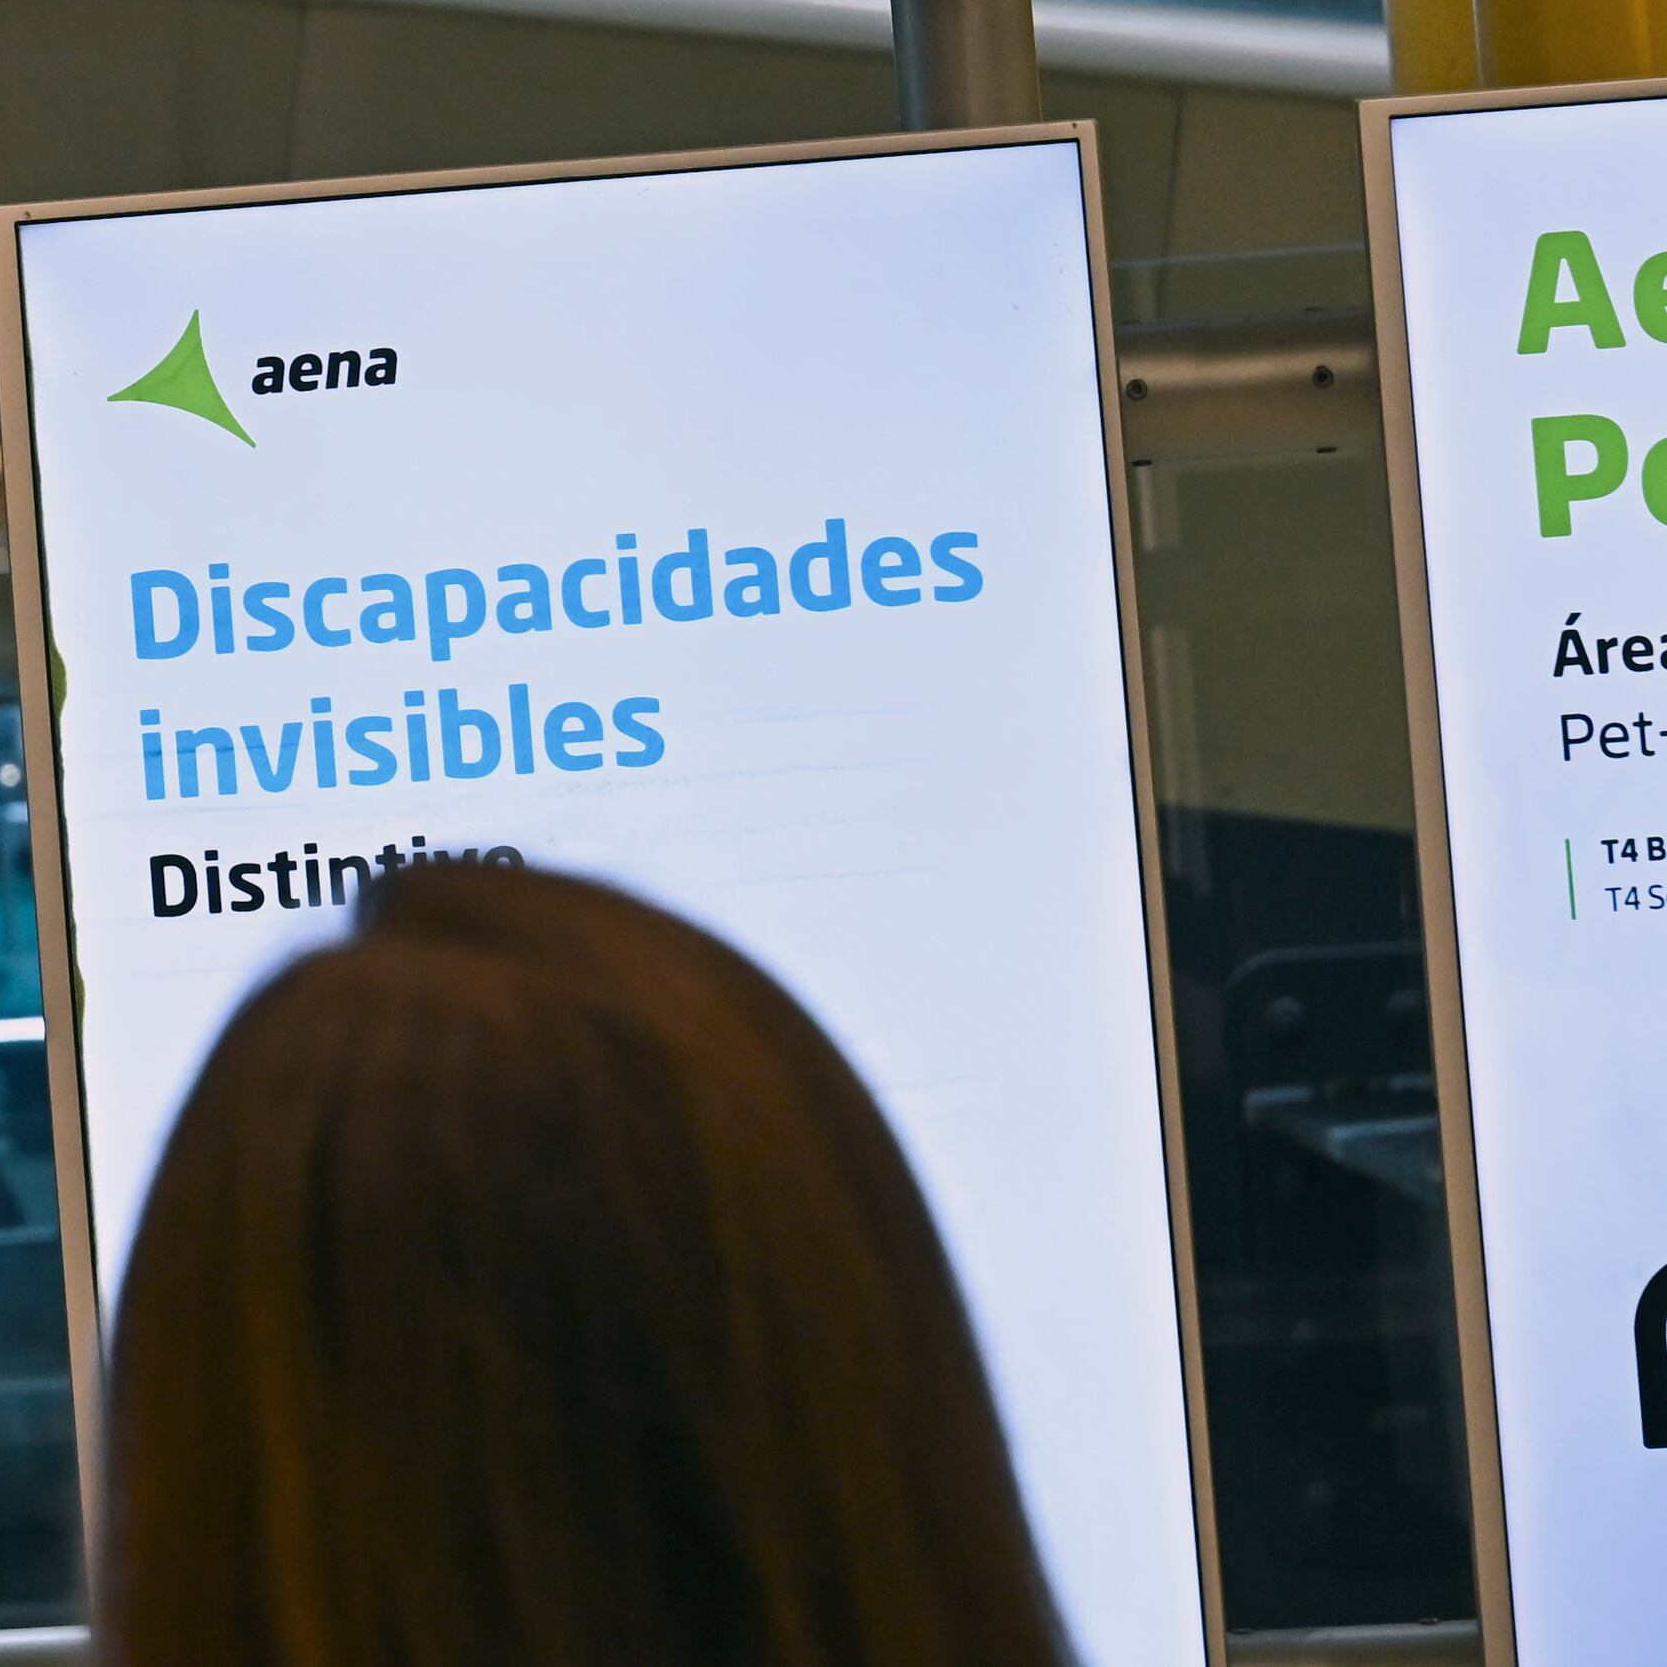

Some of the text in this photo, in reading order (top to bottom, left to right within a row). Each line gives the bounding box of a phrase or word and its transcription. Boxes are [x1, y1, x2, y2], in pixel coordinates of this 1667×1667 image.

[251, 347, 398, 395] aena
[130, 517, 984, 663] Discapacidades
[139, 681, 666, 802] invisibles
[150, 836, 525, 918] Distin
[1601, 838, 1639, 864] T4
[1605, 886, 1641, 912] T4
